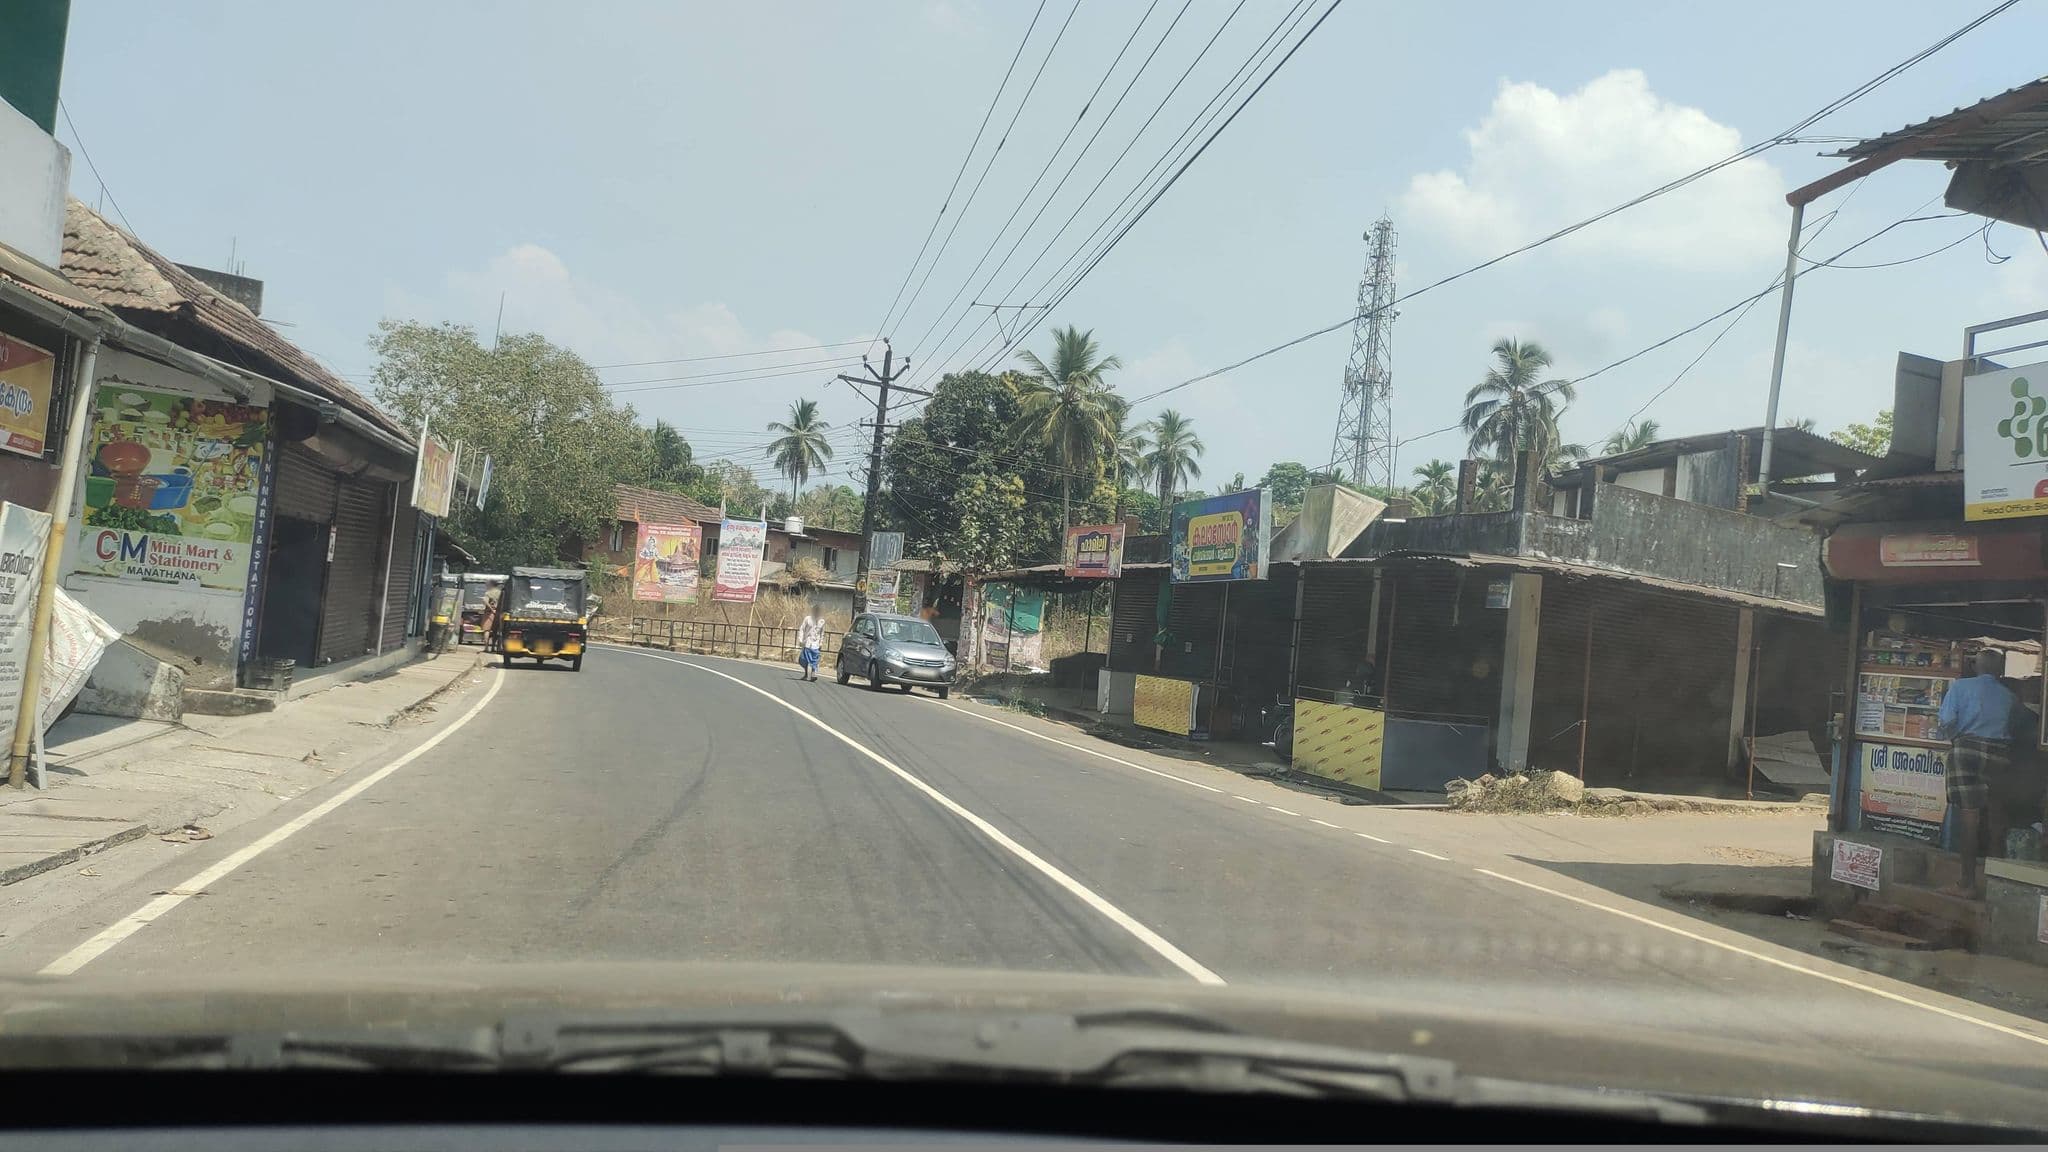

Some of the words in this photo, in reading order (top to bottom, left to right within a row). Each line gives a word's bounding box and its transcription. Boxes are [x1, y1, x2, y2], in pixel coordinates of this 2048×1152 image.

[96, 530, 149, 563] CM
[151, 540, 181, 554] Mini
[186, 544, 218, 559] Mart
[223, 548, 233, 561] &
[127, 565, 198, 581] MANATHANA
[149, 553, 223, 574] Stationery
[241, 550, 262, 662] STATIONERY
